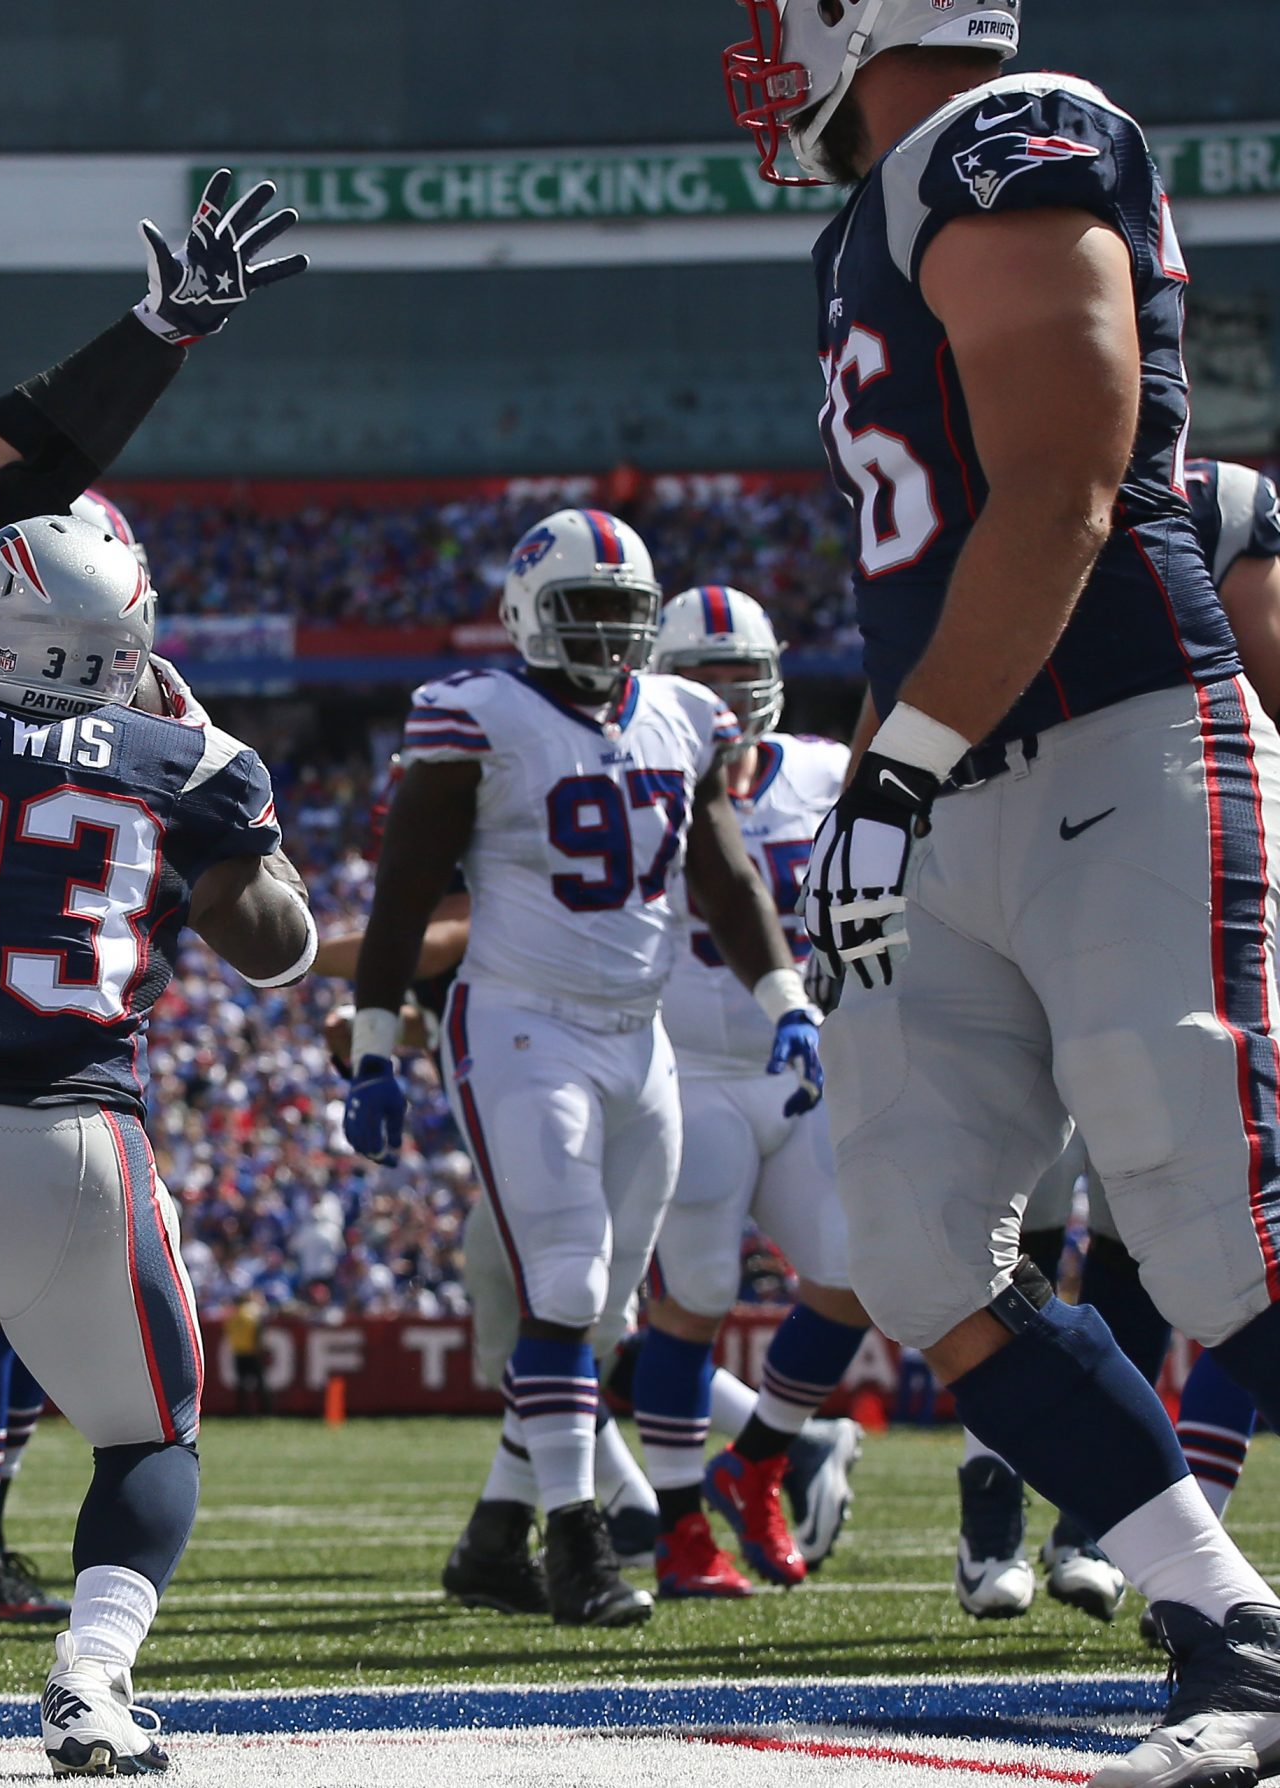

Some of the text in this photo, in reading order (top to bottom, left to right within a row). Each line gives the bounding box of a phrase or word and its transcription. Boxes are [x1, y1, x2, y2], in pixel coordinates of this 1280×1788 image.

[967, 20, 1015, 40] PATRIOTS
[21, 690, 106, 716] PATRIOT
[546, 770, 686, 912] 97
